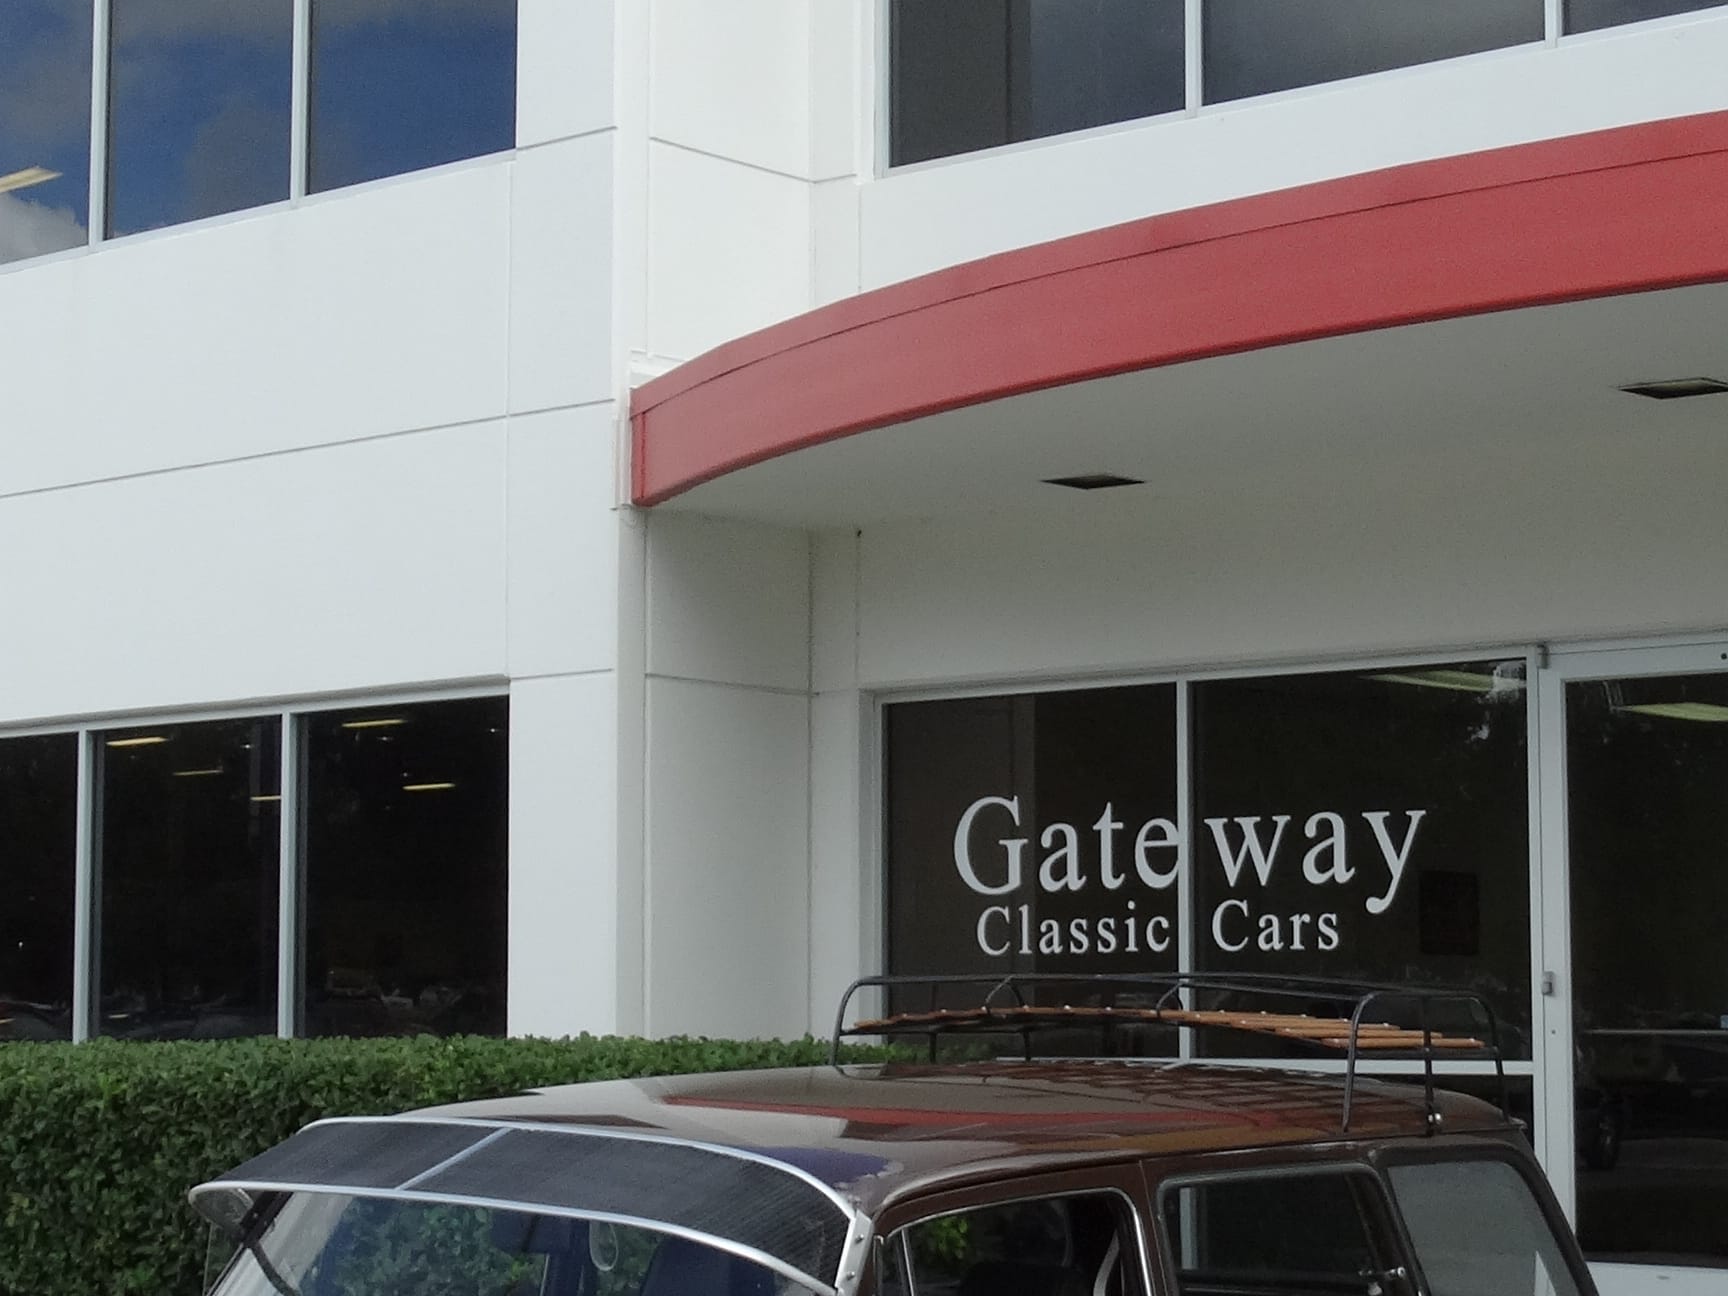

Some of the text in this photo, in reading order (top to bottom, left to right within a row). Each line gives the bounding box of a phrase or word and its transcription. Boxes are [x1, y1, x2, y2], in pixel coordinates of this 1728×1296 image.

[953, 795, 1427, 914] Gateway
[976, 899, 1339, 956] Classic Cars
